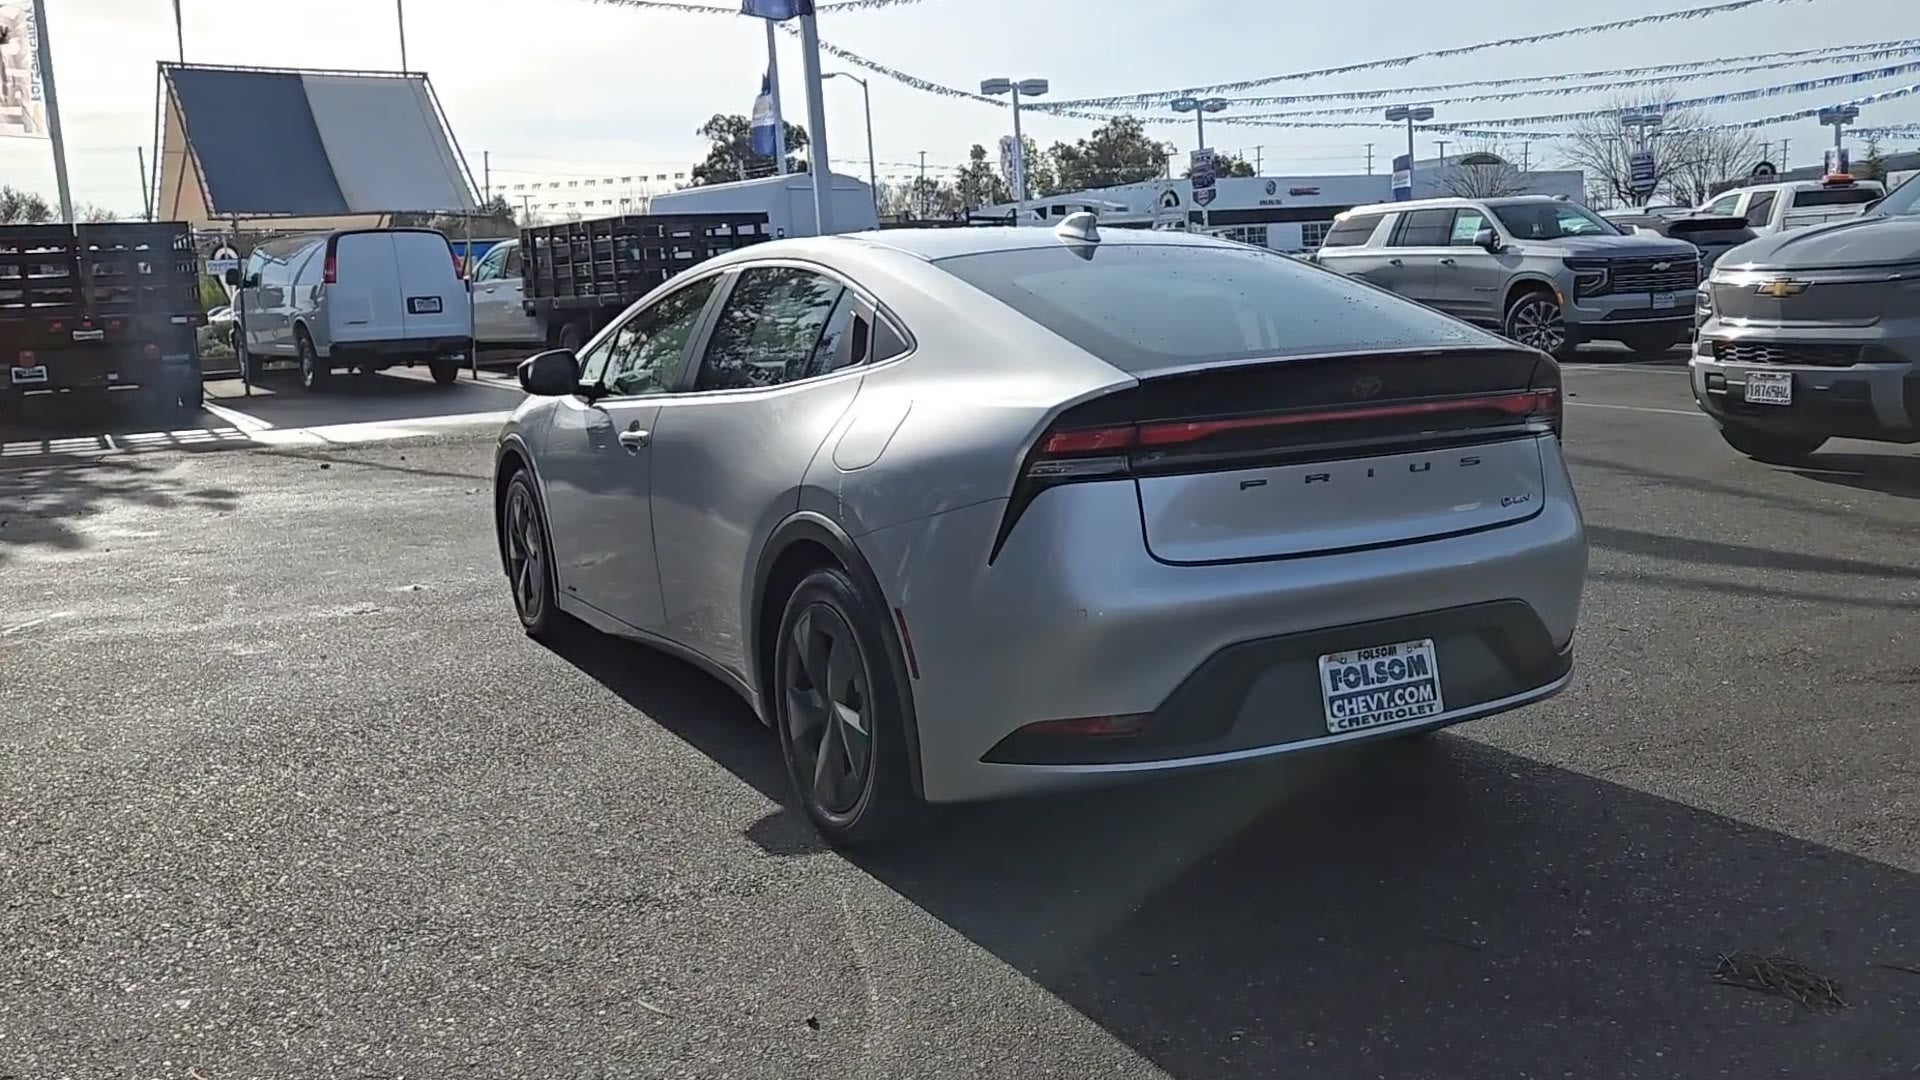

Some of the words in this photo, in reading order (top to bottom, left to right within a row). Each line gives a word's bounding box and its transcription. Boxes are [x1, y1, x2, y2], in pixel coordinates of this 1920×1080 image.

[1240, 456, 1481, 490] PRIUS
[1357, 645, 1398, 661] FOLSOM
[1329, 654, 1429, 692] FOLSOM
[1332, 684, 1434, 719] CHEVY.COM
[1337, 703, 1436, 729] CHEVROLET
